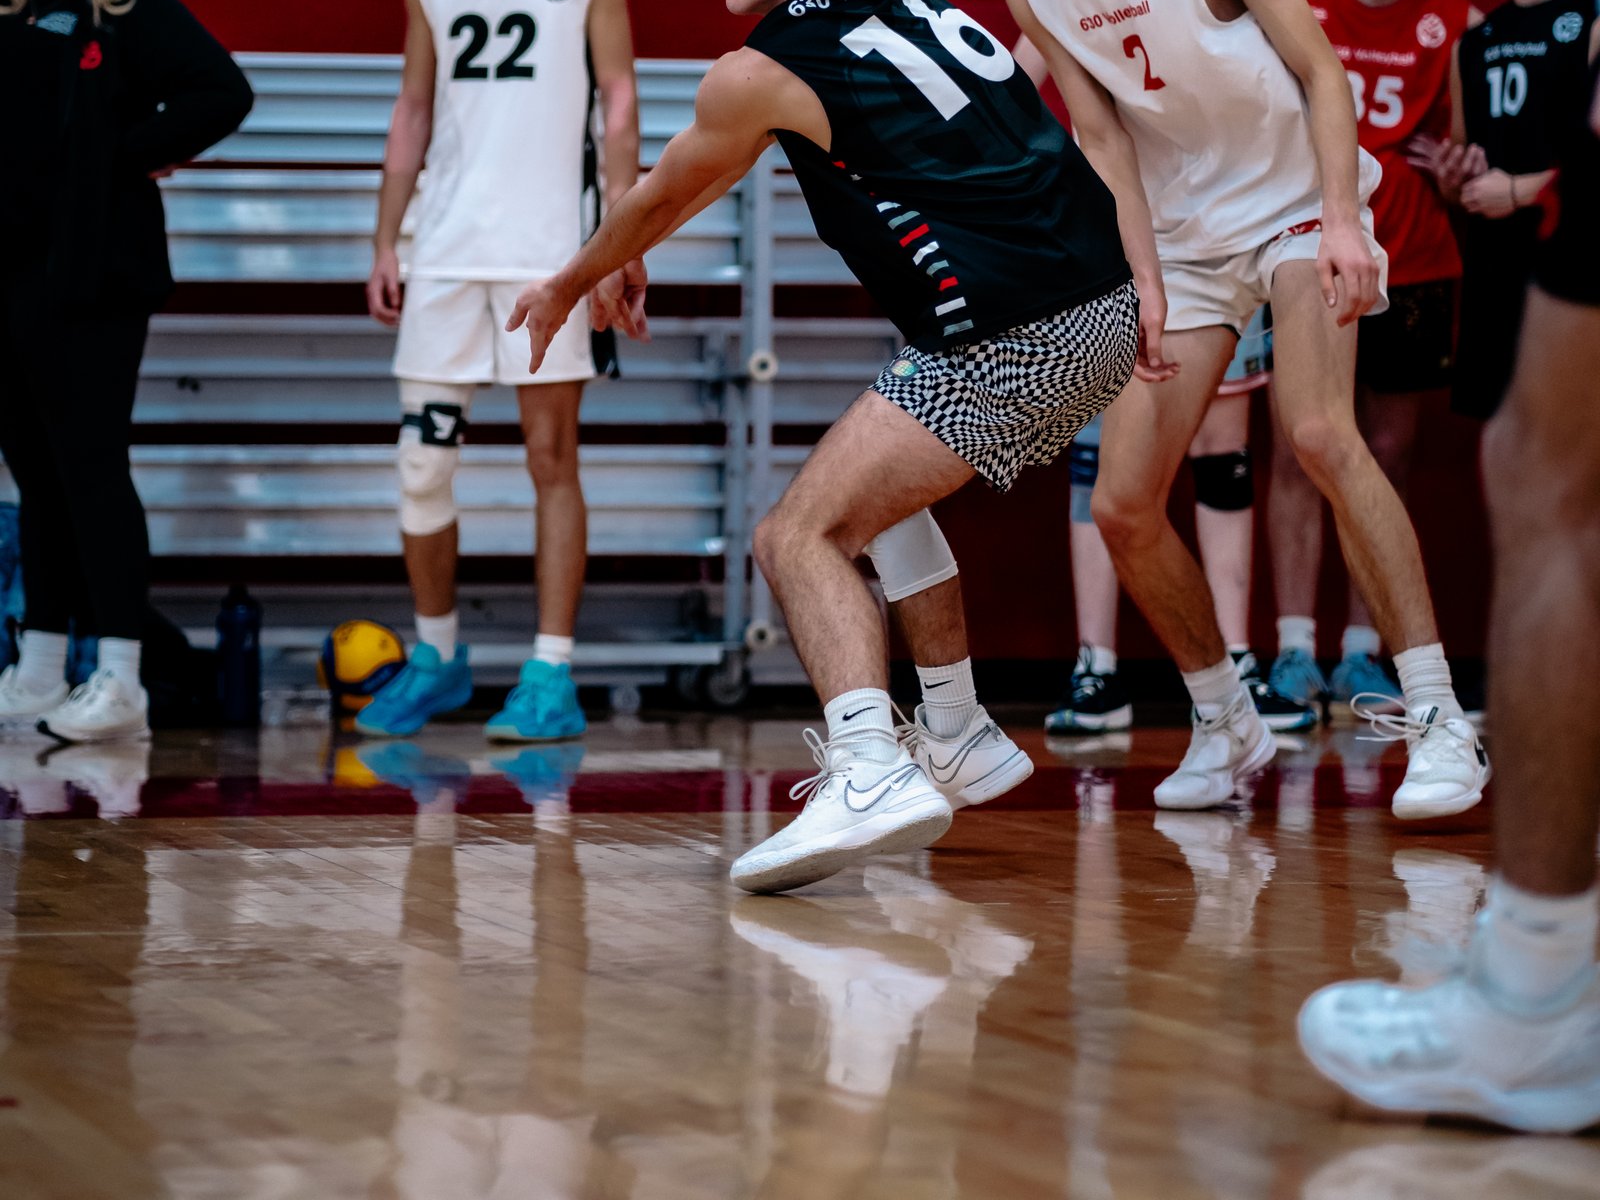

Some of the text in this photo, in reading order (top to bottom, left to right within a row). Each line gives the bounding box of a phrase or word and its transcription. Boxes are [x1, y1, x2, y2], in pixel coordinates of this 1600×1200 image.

[1080, 0, 1151, 32] 630 Volleball
[450, 12, 537, 80] 22
[1122, 34, 1167, 91] 2
[1486, 62, 1528, 118] 10
